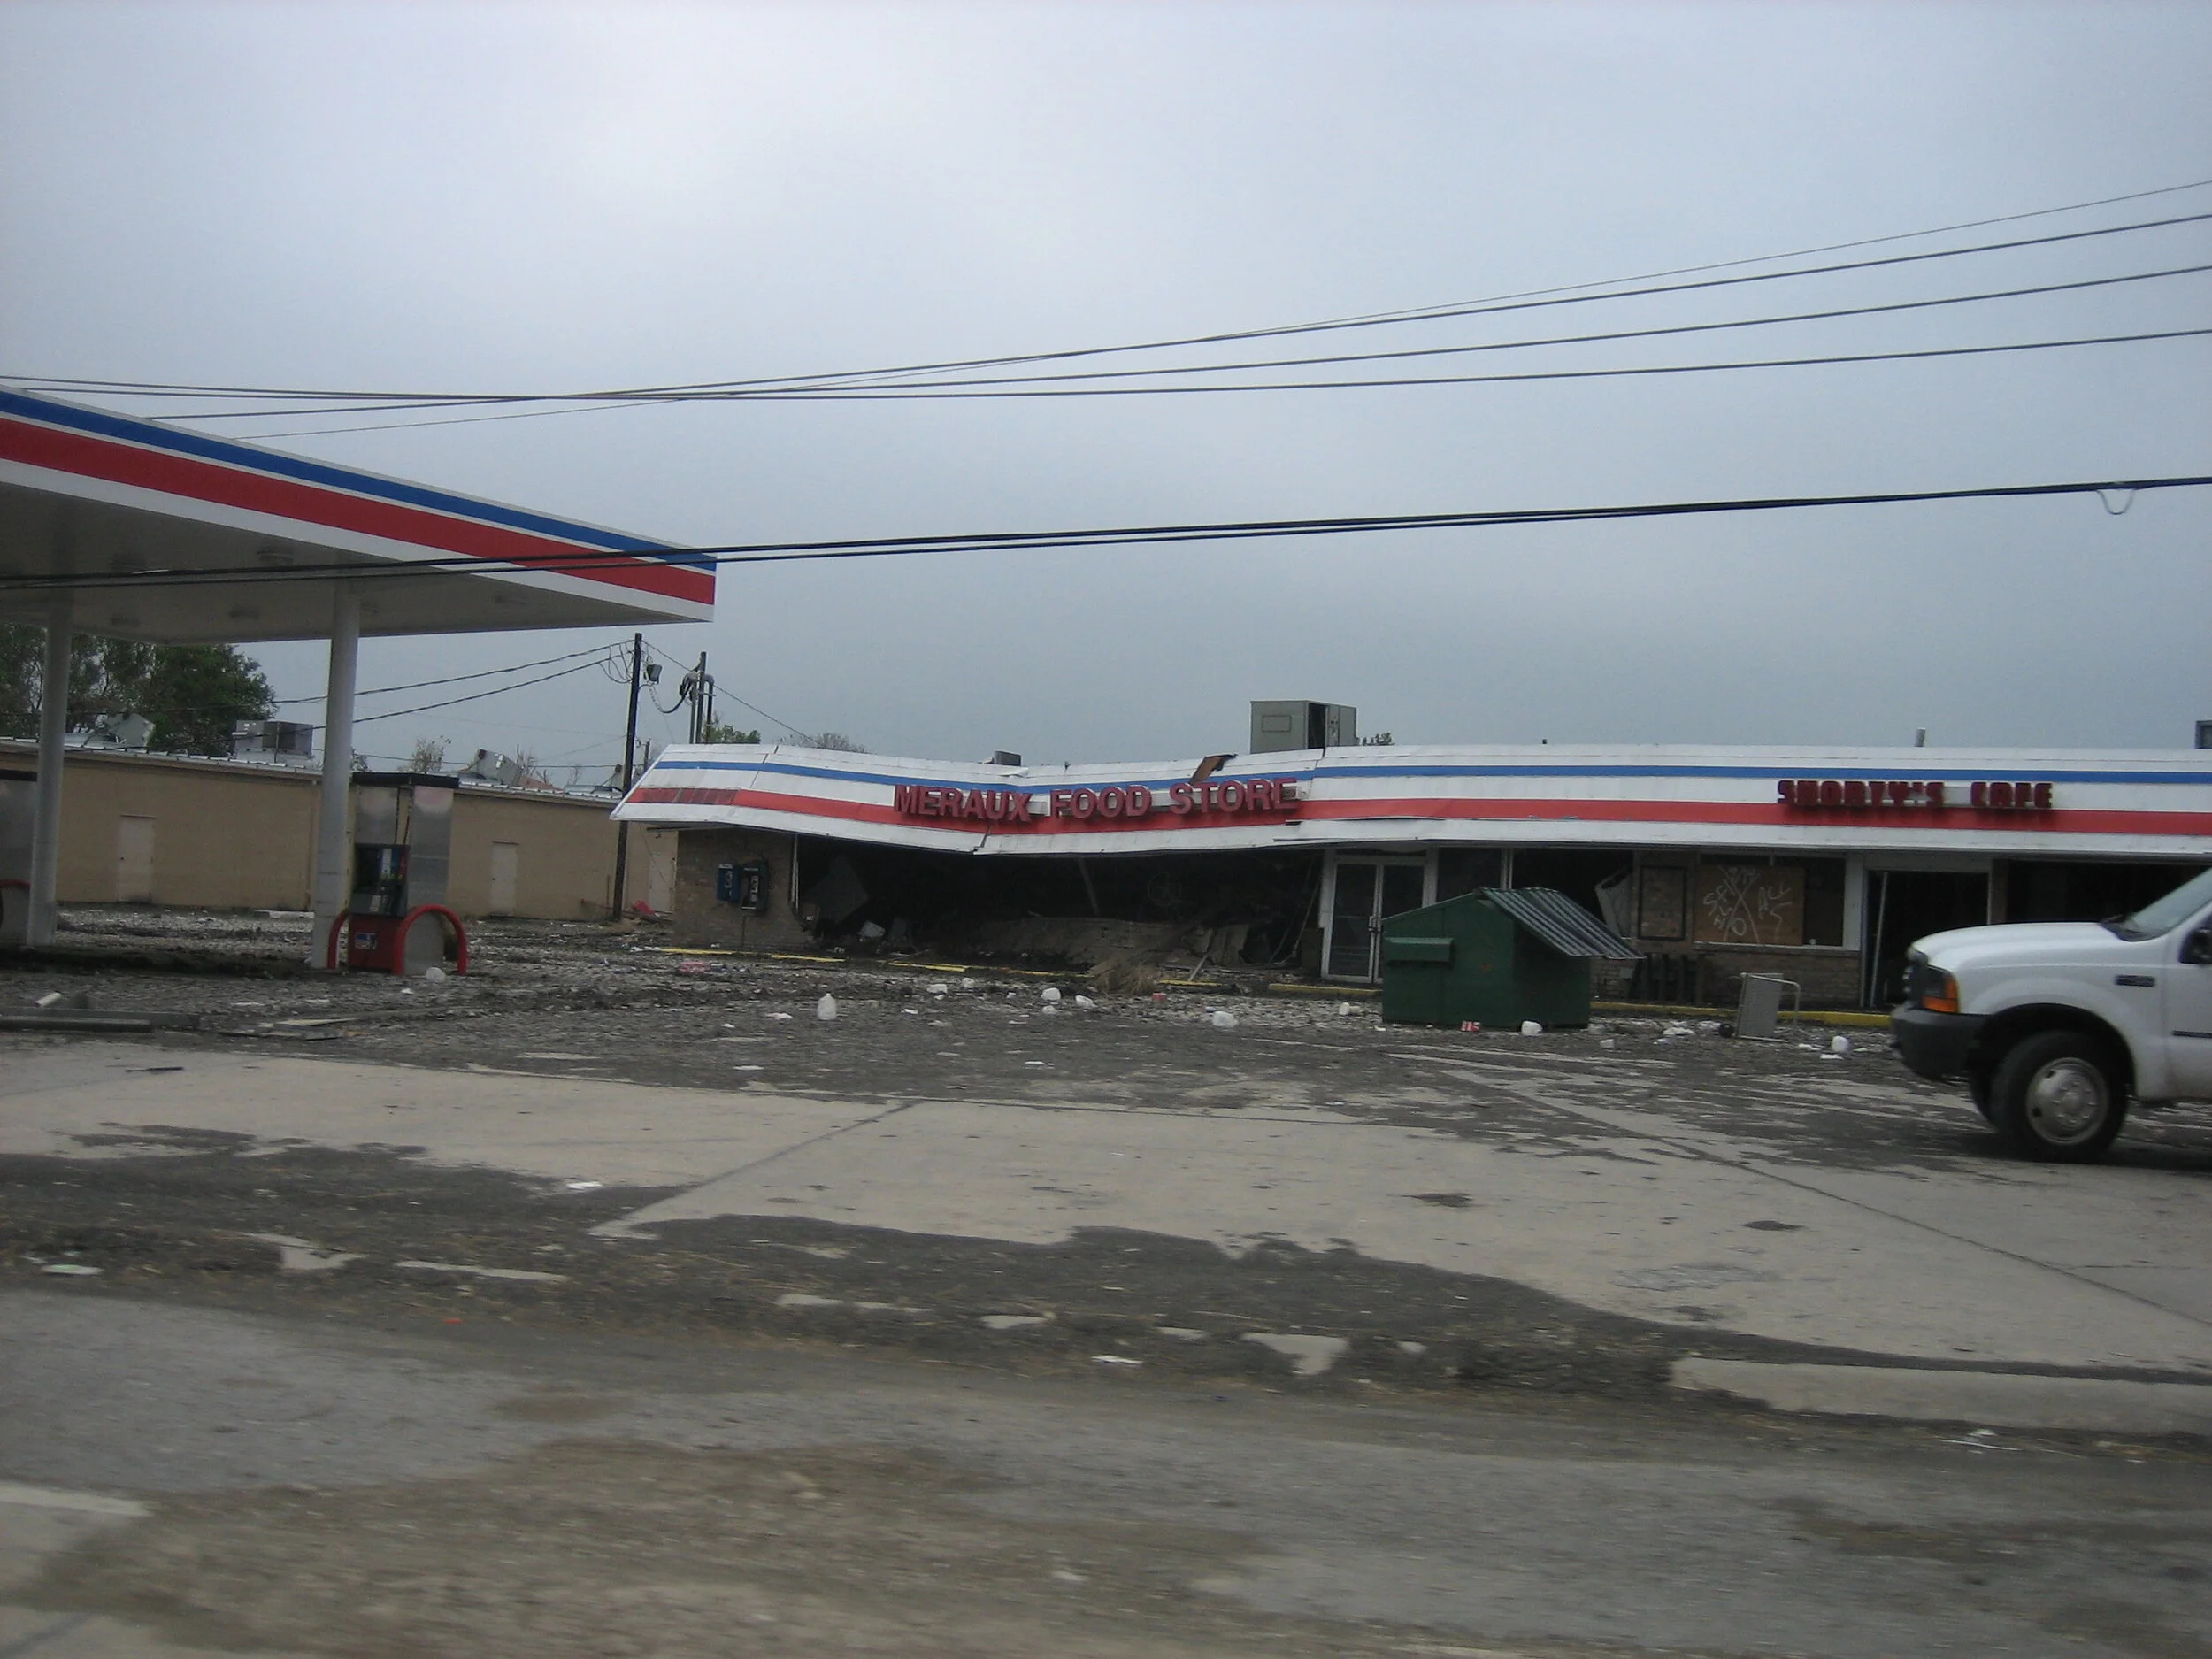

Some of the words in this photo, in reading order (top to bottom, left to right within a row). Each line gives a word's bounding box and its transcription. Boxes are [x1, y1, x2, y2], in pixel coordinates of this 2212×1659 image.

[894, 783, 1033, 822] MERAUX
[1050, 785, 1151, 819] FOOD
[1169, 777, 1300, 815] STORE
